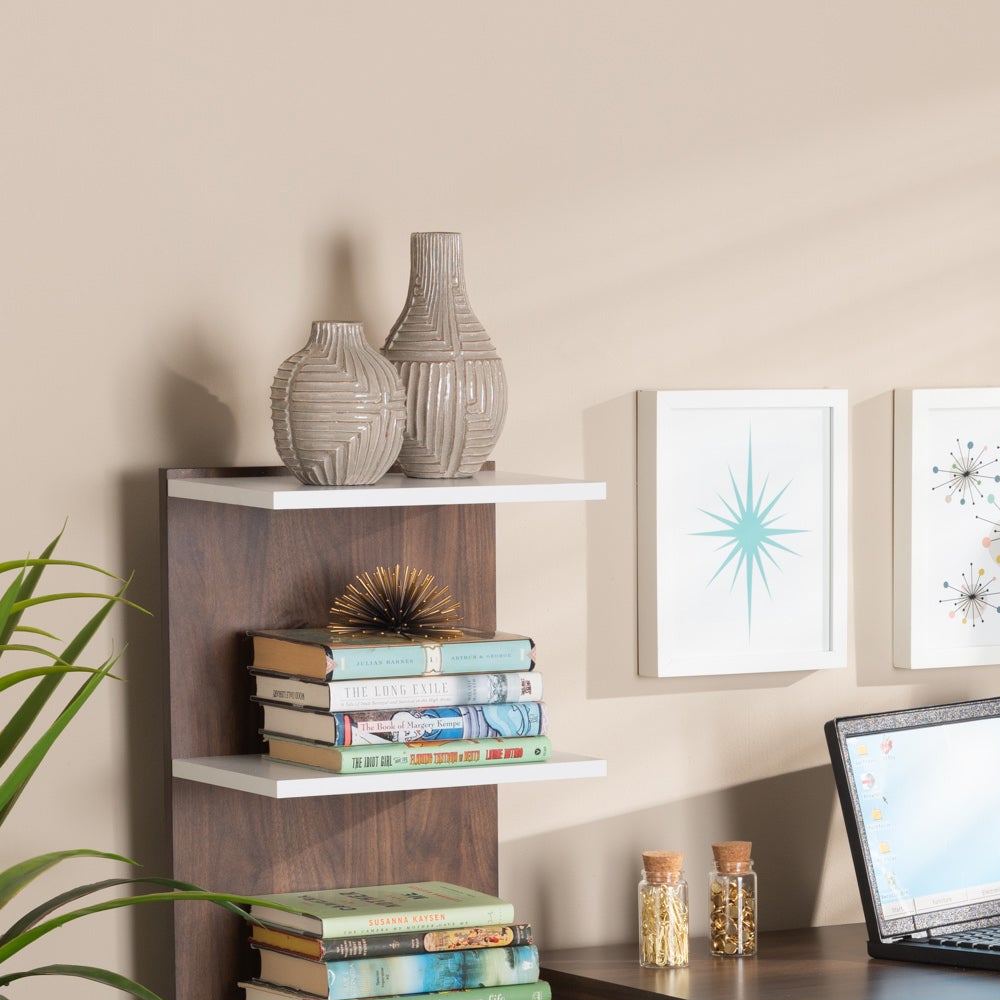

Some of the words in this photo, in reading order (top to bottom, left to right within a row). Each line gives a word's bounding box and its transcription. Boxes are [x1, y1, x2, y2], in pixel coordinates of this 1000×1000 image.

[344, 686, 368, 698] THE
[375, 685, 407, 697] LONG
[412, 682, 449, 695] EXILE
[361, 723, 375, 731] The
[377, 722, 396, 730] Book
[397, 721, 405, 729] of
[407, 721, 435, 731] Margery
[437, 719, 461, 729] Kempe
[352, 757, 363, 768] THE
[364, 756, 379, 768] IDIOT
[380, 755, 393, 767] GIRL
[368, 916, 408, 927] SUSANNA
[412, 913, 446, 923] KAYSEN
